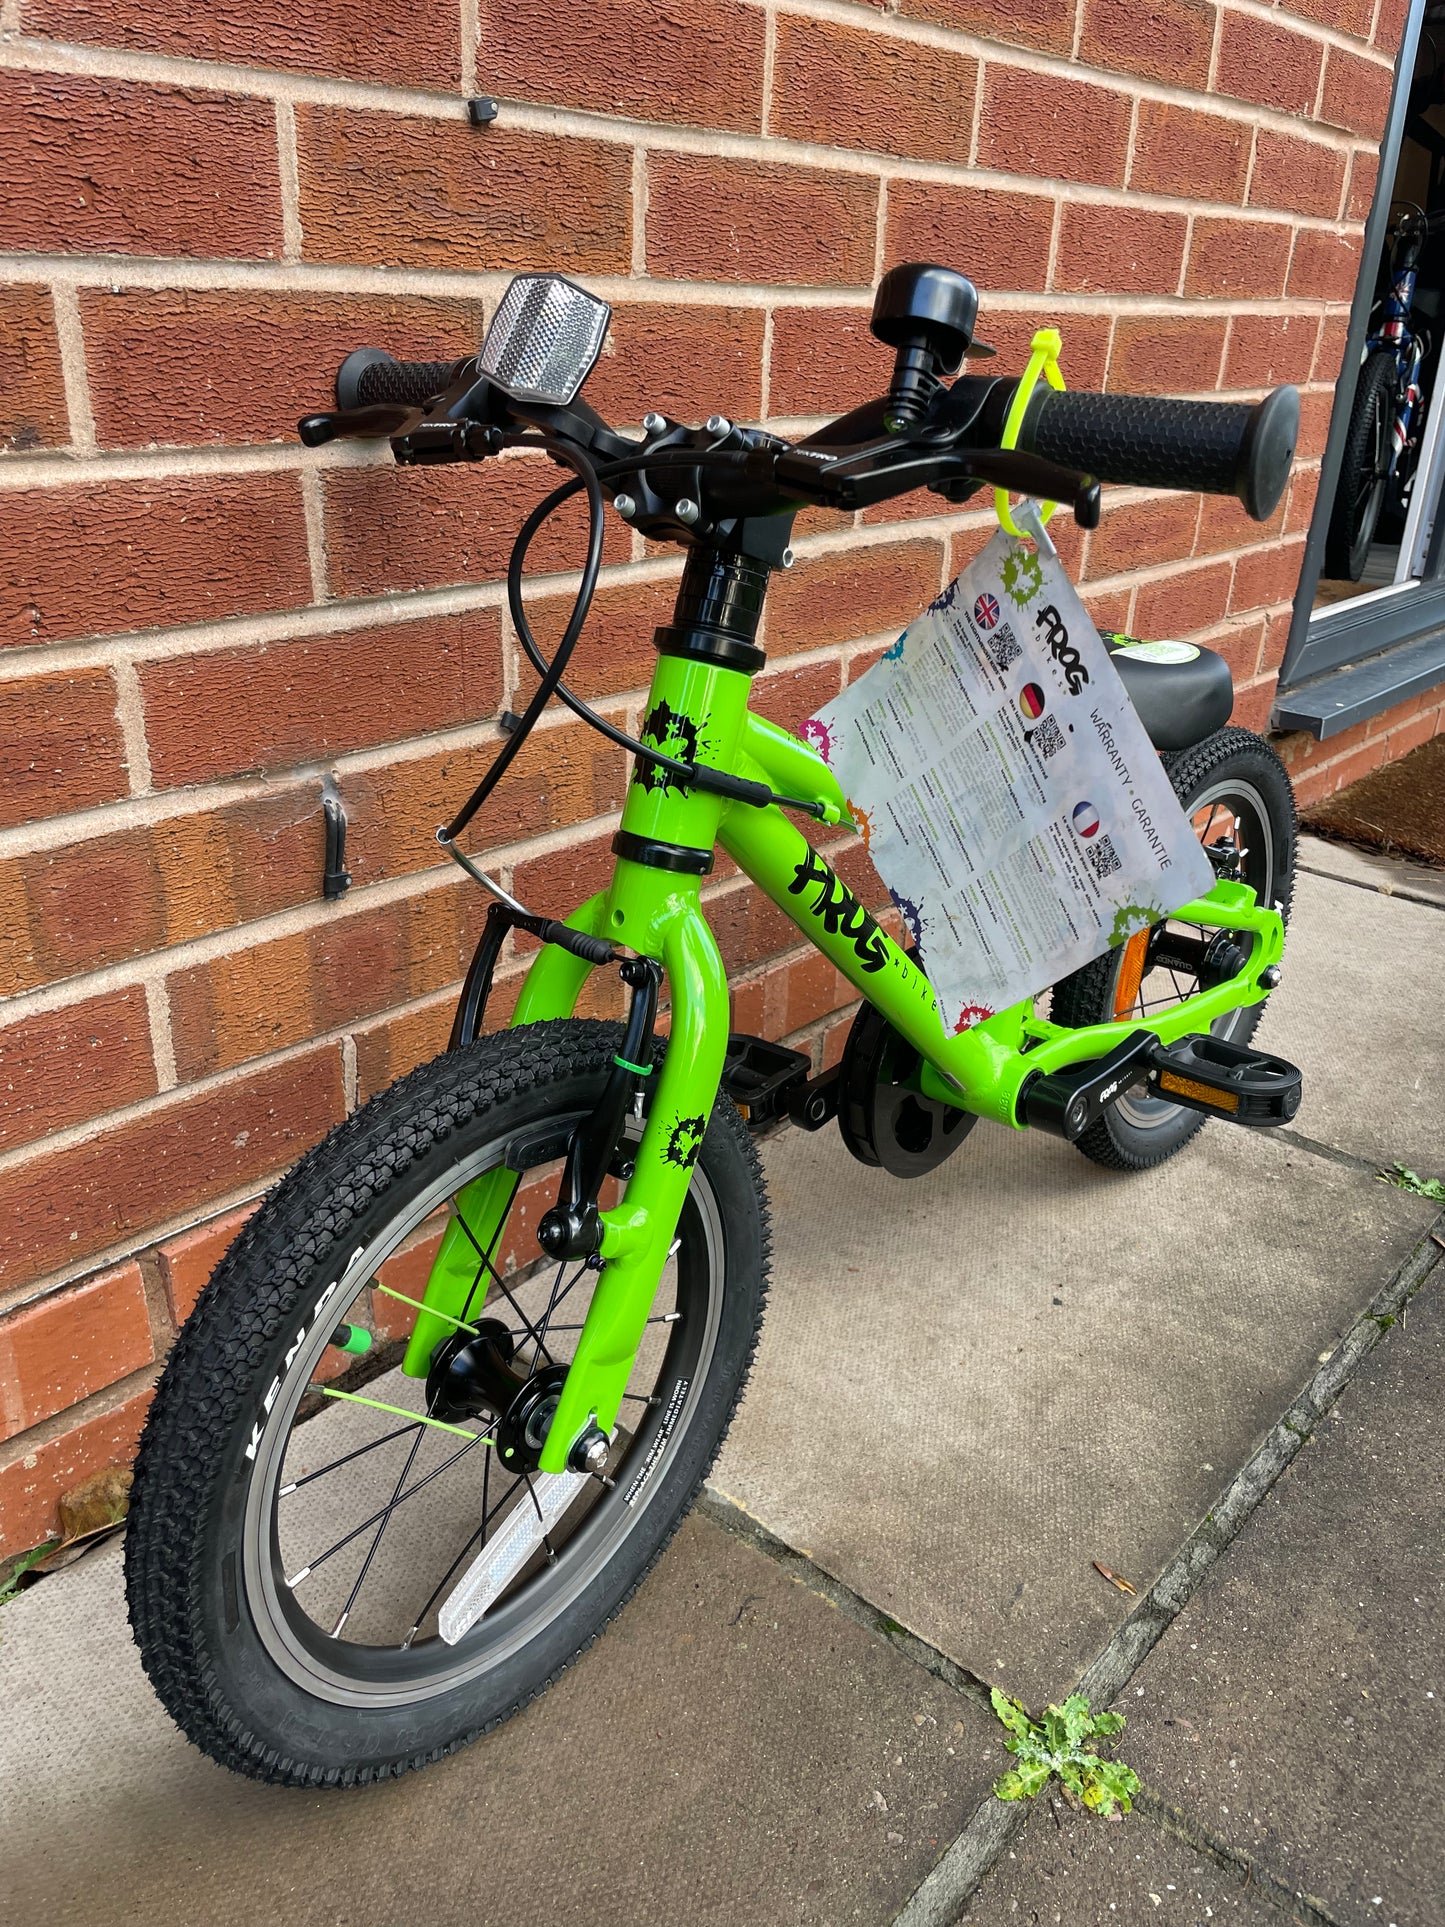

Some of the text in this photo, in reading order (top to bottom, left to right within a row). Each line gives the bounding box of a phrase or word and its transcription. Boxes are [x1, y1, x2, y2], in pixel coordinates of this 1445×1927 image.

[963, 610, 971, 622] THE
[969, 622, 991, 660] LIGHTWEIGHT
[997, 675, 1007, 690] BIKE
[1036, 605, 1089, 696] FROG
[1036, 635, 1062, 687] bikes
[997, 710, 1008, 731] Fahrrad
[1008, 698, 1016, 711] Das
[1038, 790, 1047, 803] Frog
[1090, 708, 1171, 870] WARRANTY GARANTIE
[1065, 823, 1074, 839] vélo
[1079, 856, 1089, 872] pour
[1087, 872, 1101, 898] enfants
[788, 847, 889, 973] FROG
[1156, 956, 1193, 971] QUANDO
[623, 1480, 639, 1501] WHEN
[636, 1466, 646, 1480] THE
[662, 1410, 672, 1424] LINE
[671, 1379, 683, 1401] WORN
[628, 1380, 689, 1507] REPLACE THE RIM IMMEDIATELY
